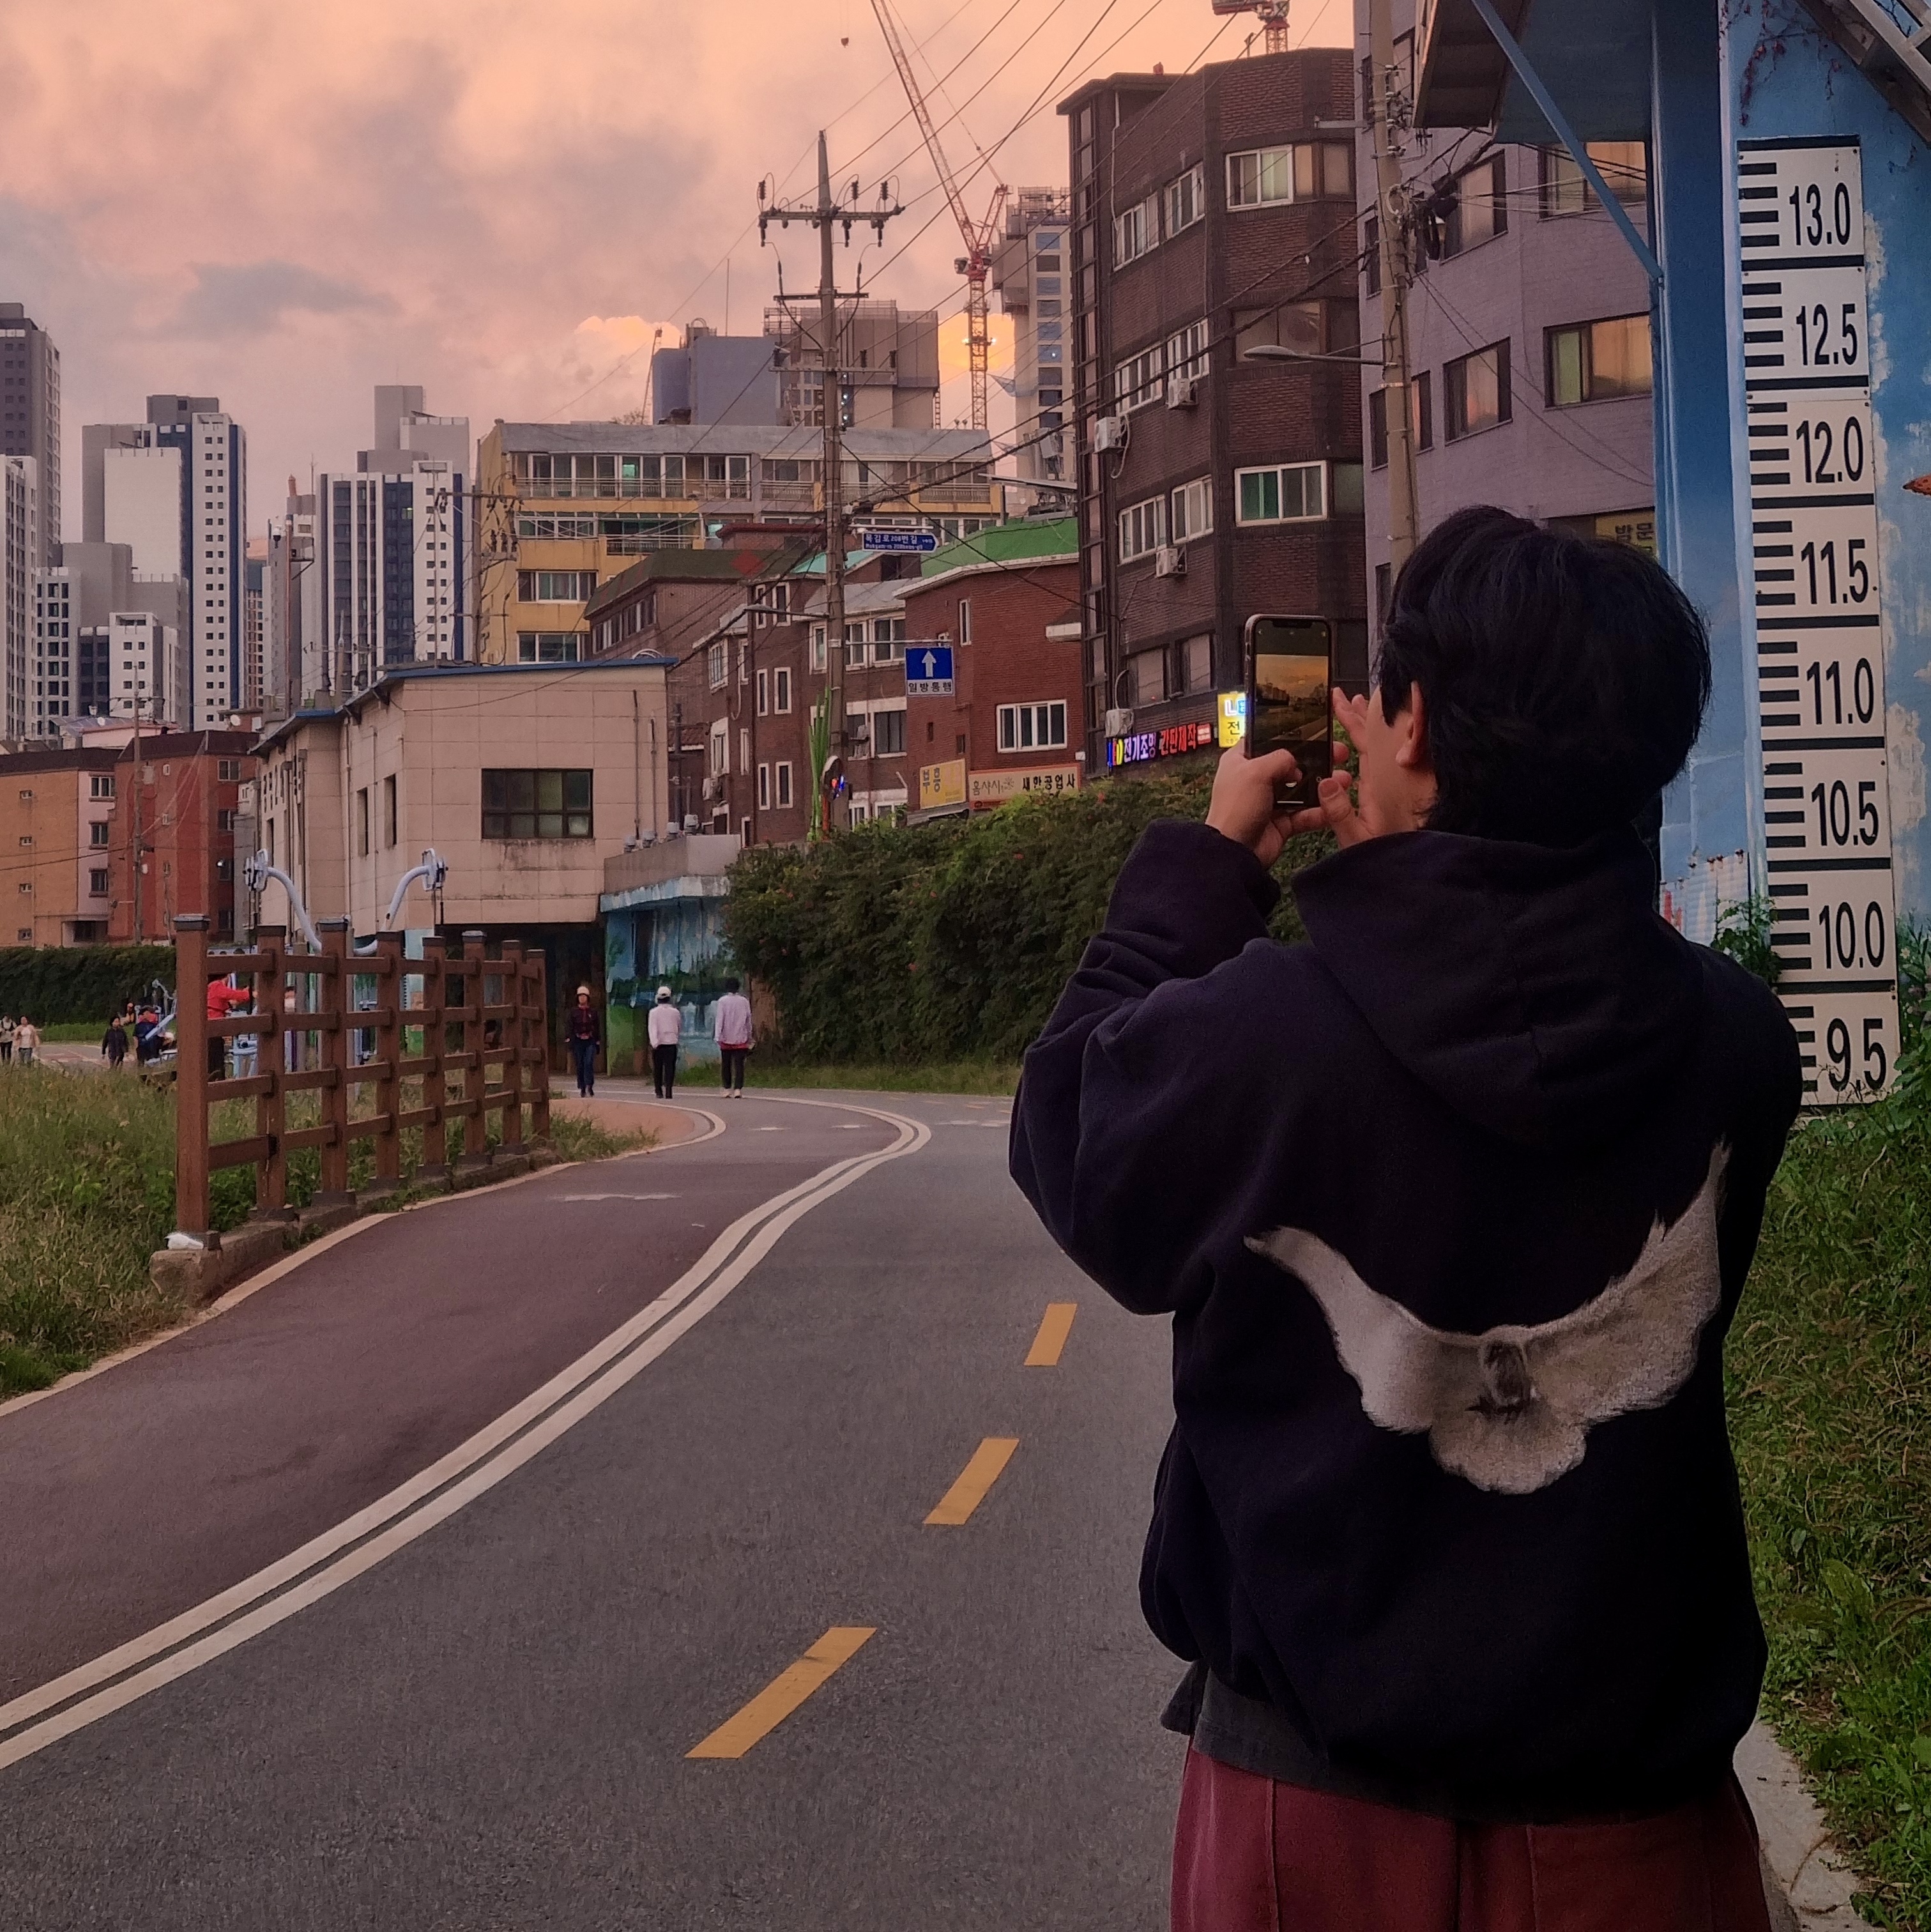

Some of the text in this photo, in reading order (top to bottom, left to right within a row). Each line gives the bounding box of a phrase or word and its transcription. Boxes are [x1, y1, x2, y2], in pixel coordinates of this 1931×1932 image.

[1789, 183, 1851, 246] 13.0
[1796, 303, 1858, 366] 12.5
[1796, 416, 1864, 484] 12.0
[1801, 539, 1868, 604] 11.5
[908, 682, 952, 693] 일방통행
[1806, 658, 1874, 725] 11.0
[1159, 723, 1196, 756] 간판제작
[1023, 773, 1076, 792] 새한공업사
[1812, 780, 1879, 847] 10.5
[1819, 901, 1884, 969] 10.0
[1827, 1018, 1886, 1091] 9.5
